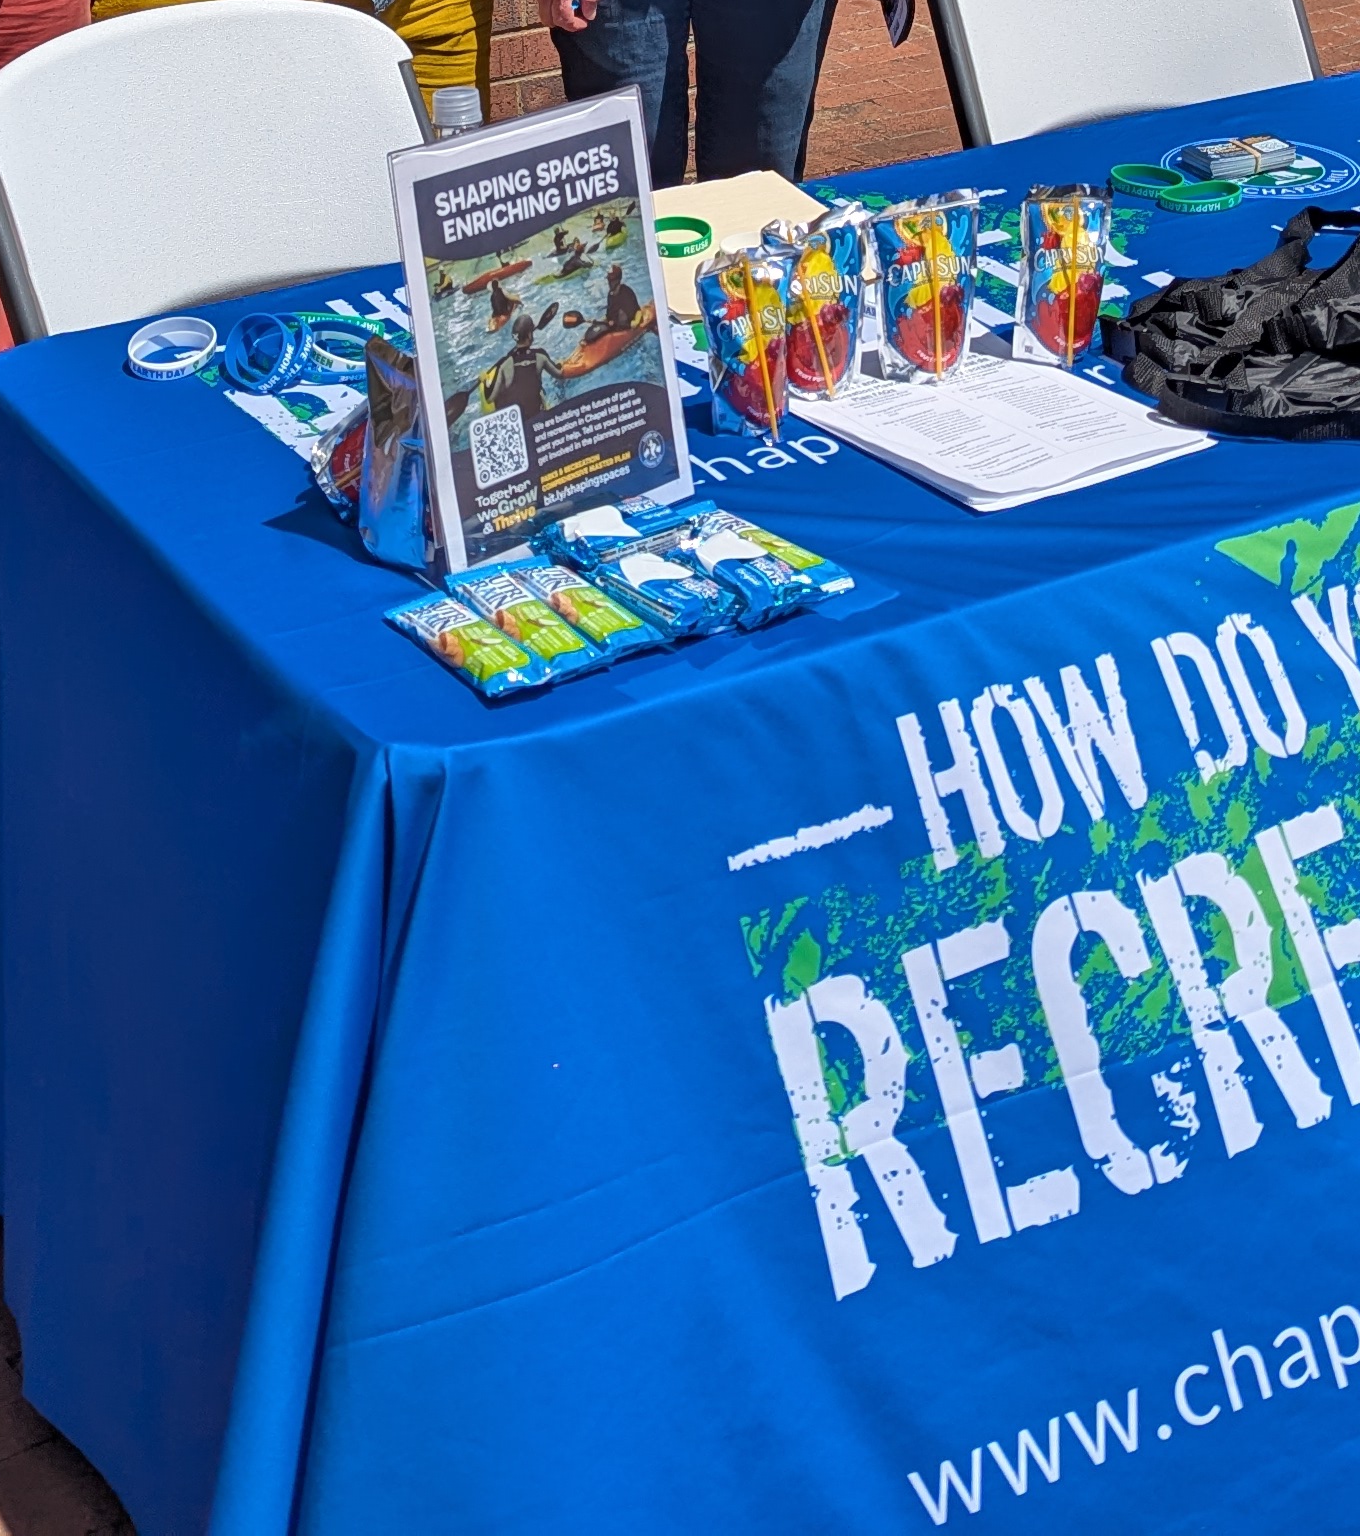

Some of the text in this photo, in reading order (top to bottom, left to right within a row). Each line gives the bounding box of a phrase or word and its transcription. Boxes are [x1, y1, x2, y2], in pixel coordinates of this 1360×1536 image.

[434, 144, 618, 216] SHAPING SPACES,
[1243, 183, 1331, 196] CHAPEL
[442, 169, 619, 244] ENRICHING LIVES
[1190, 203, 1221, 213] HAPPY
[683, 240, 710, 255] REUSE
[278, 342, 294, 375] HOME
[300, 334, 312, 362] SAVE
[312, 350, 333, 368] REEN
[166, 368, 186, 379] DAY
[258, 375, 281, 392] OUR
[475, 480, 531, 507] Together
[543, 465, 631, 507] bit.ly/shapingspaces
[476, 508, 499, 523] We
[483, 506, 536, 535] & Thrive
[471, 580, 507, 609] RAIN
[491, 574, 528, 601] UTRI
[895, 653, 1148, 874] HOW
[1150, 611, 1309, 786] DO
